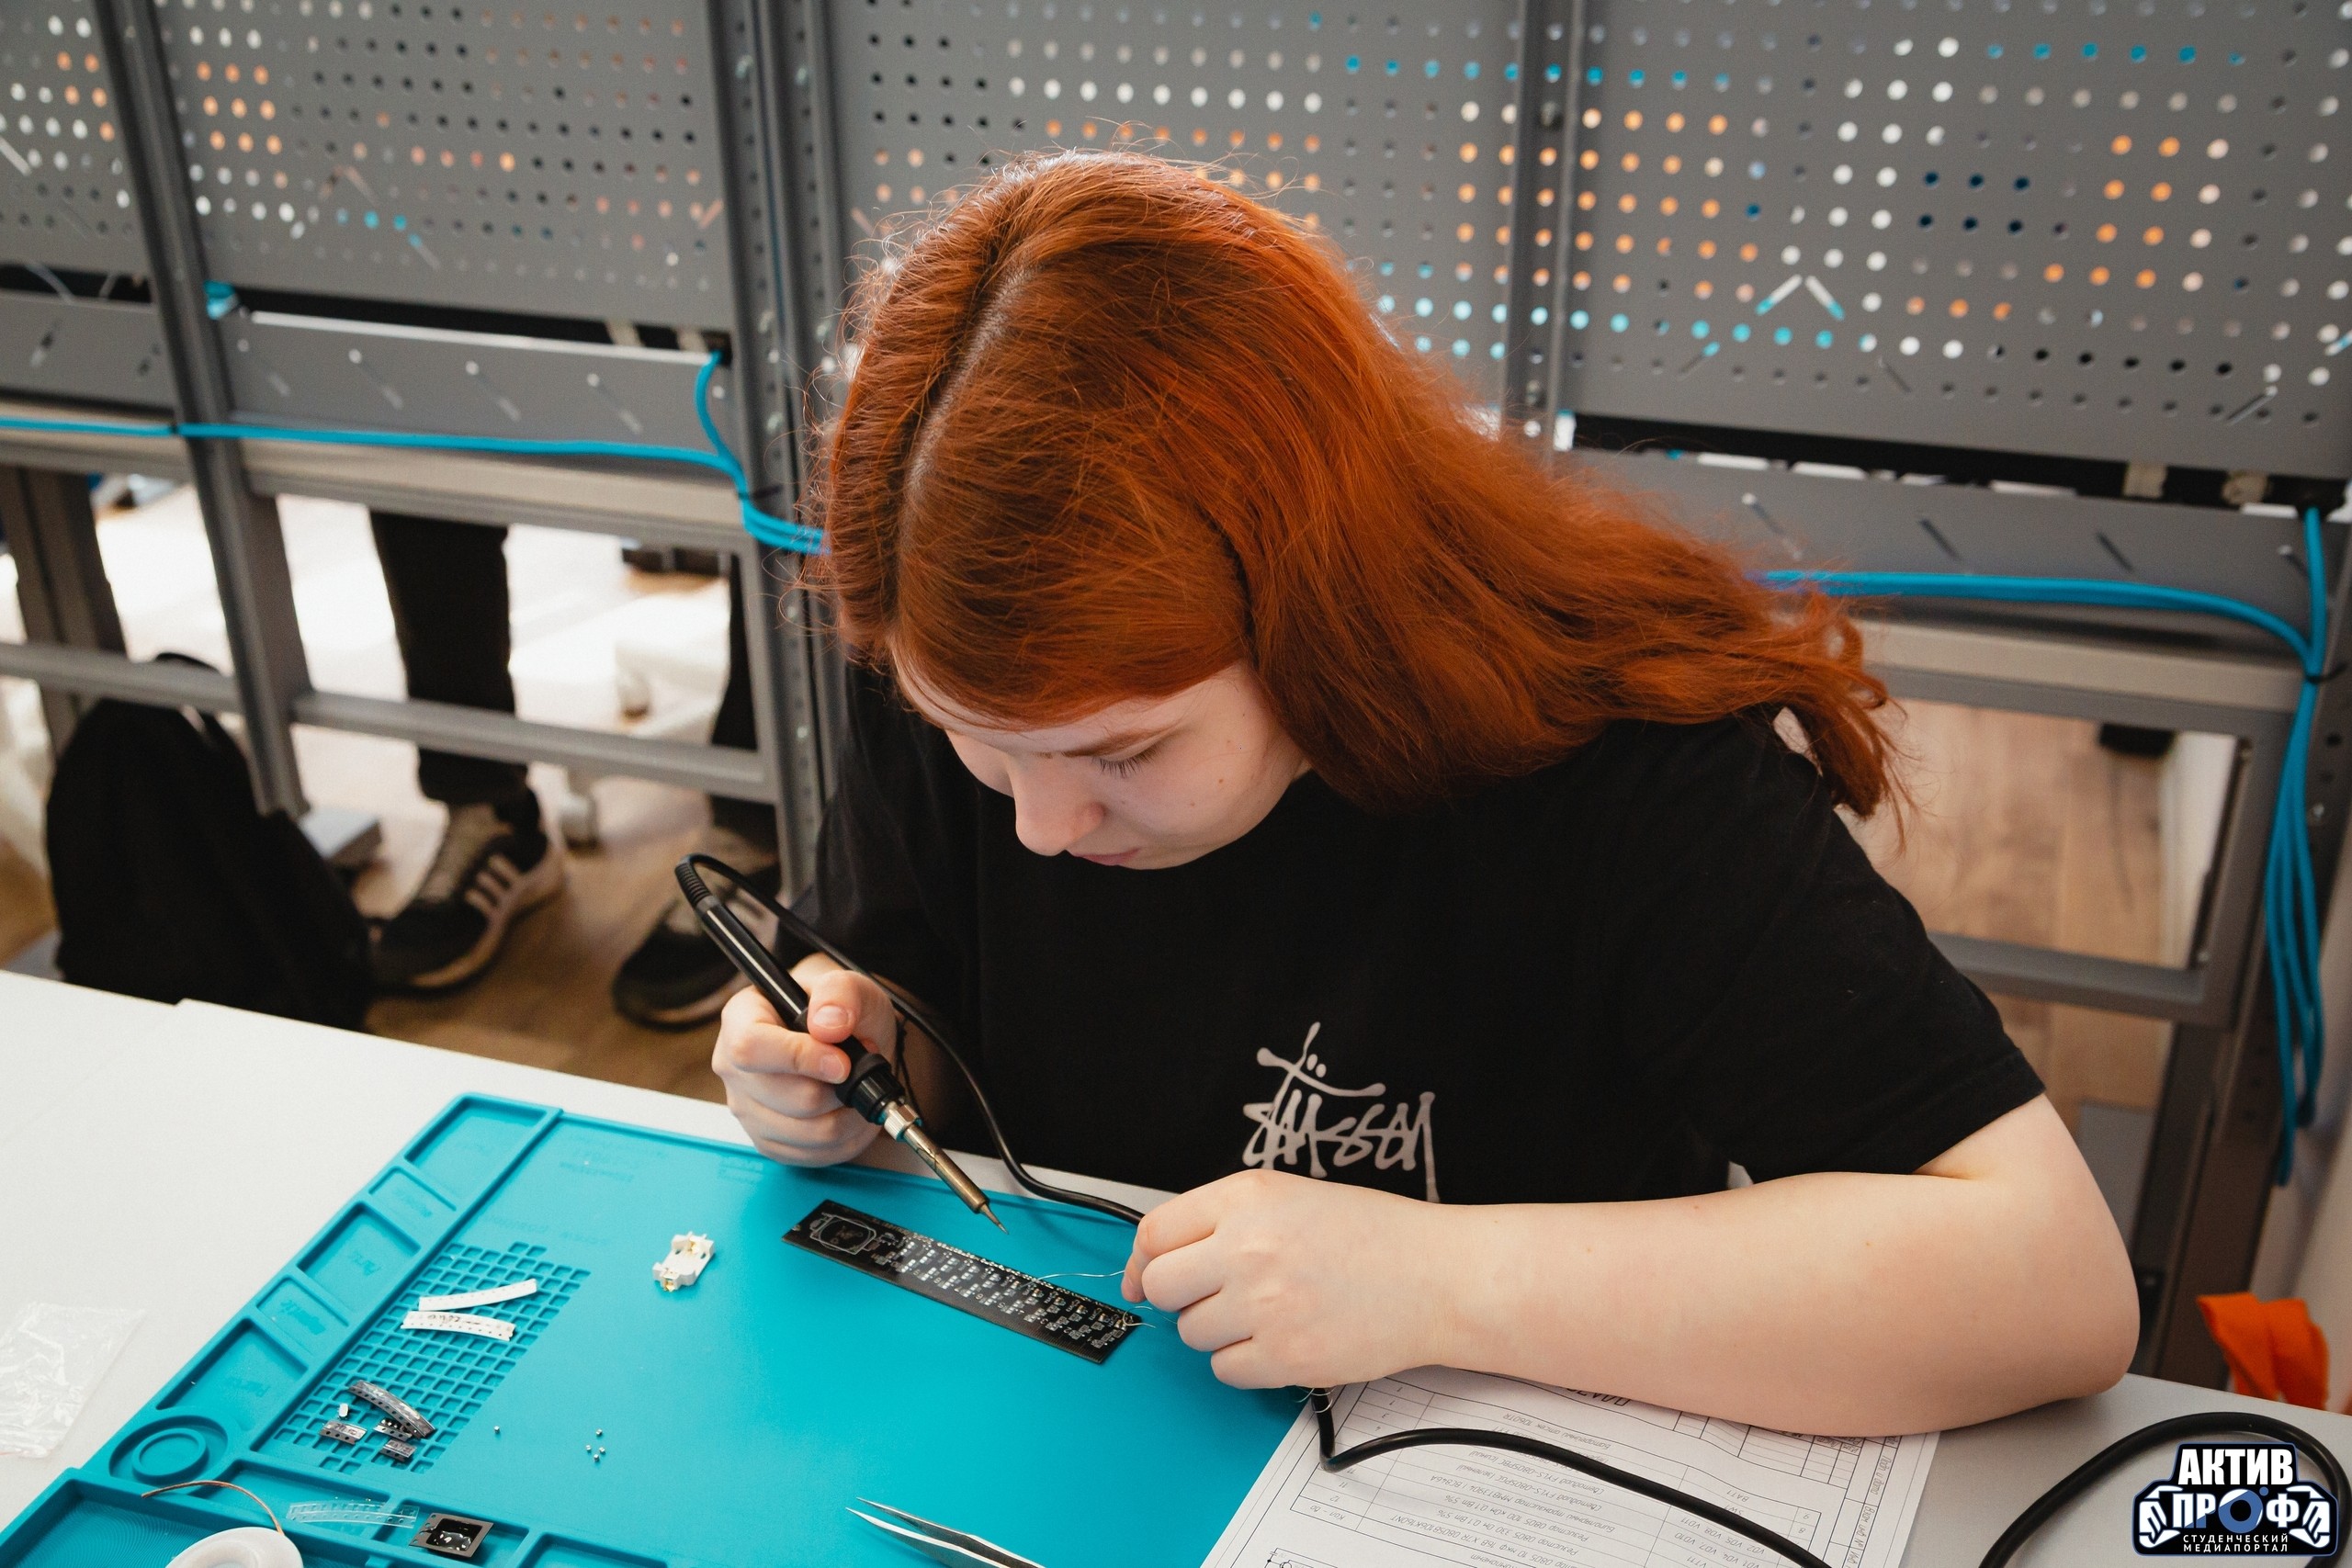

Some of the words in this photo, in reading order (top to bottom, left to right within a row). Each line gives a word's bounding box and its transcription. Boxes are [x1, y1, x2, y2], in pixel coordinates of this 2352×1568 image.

[1536, 1424, 1561, 1435] отсек
[1562, 1431, 1611, 1450] Батарейный
[1558, 1478, 1604, 1495] Светодиод
[1330, 1495, 1340, 1503] 12
[1444, 1495, 1461, 1505] 5%
[1726, 1490, 1749, 1503] BAT1
[1514, 1497, 1565, 1518] транзистор
[1556, 1494, 1602, 1512] Светодиод
[1437, 1510, 1453, 1519] 5%
[1507, 1512, 1521, 1522] 100
[1525, 1517, 1547, 1529] 0805
[1566, 1514, 1615, 1532] Биполярный
[1679, 1517, 1701, 1529] VD11
[1495, 1527, 1514, 1536] 330
[1512, 1532, 1536, 1543] 0805
[1548, 1525, 1589, 1542] Резистор
[1461, 1534, 1479, 1547] X7R
[1674, 1532, 1696, 1545] VD10
[1538, 1539, 1578, 1556] Резистор
[1529, 1554, 1553, 1565] 0805
[1687, 1556, 1707, 1568] VT11
